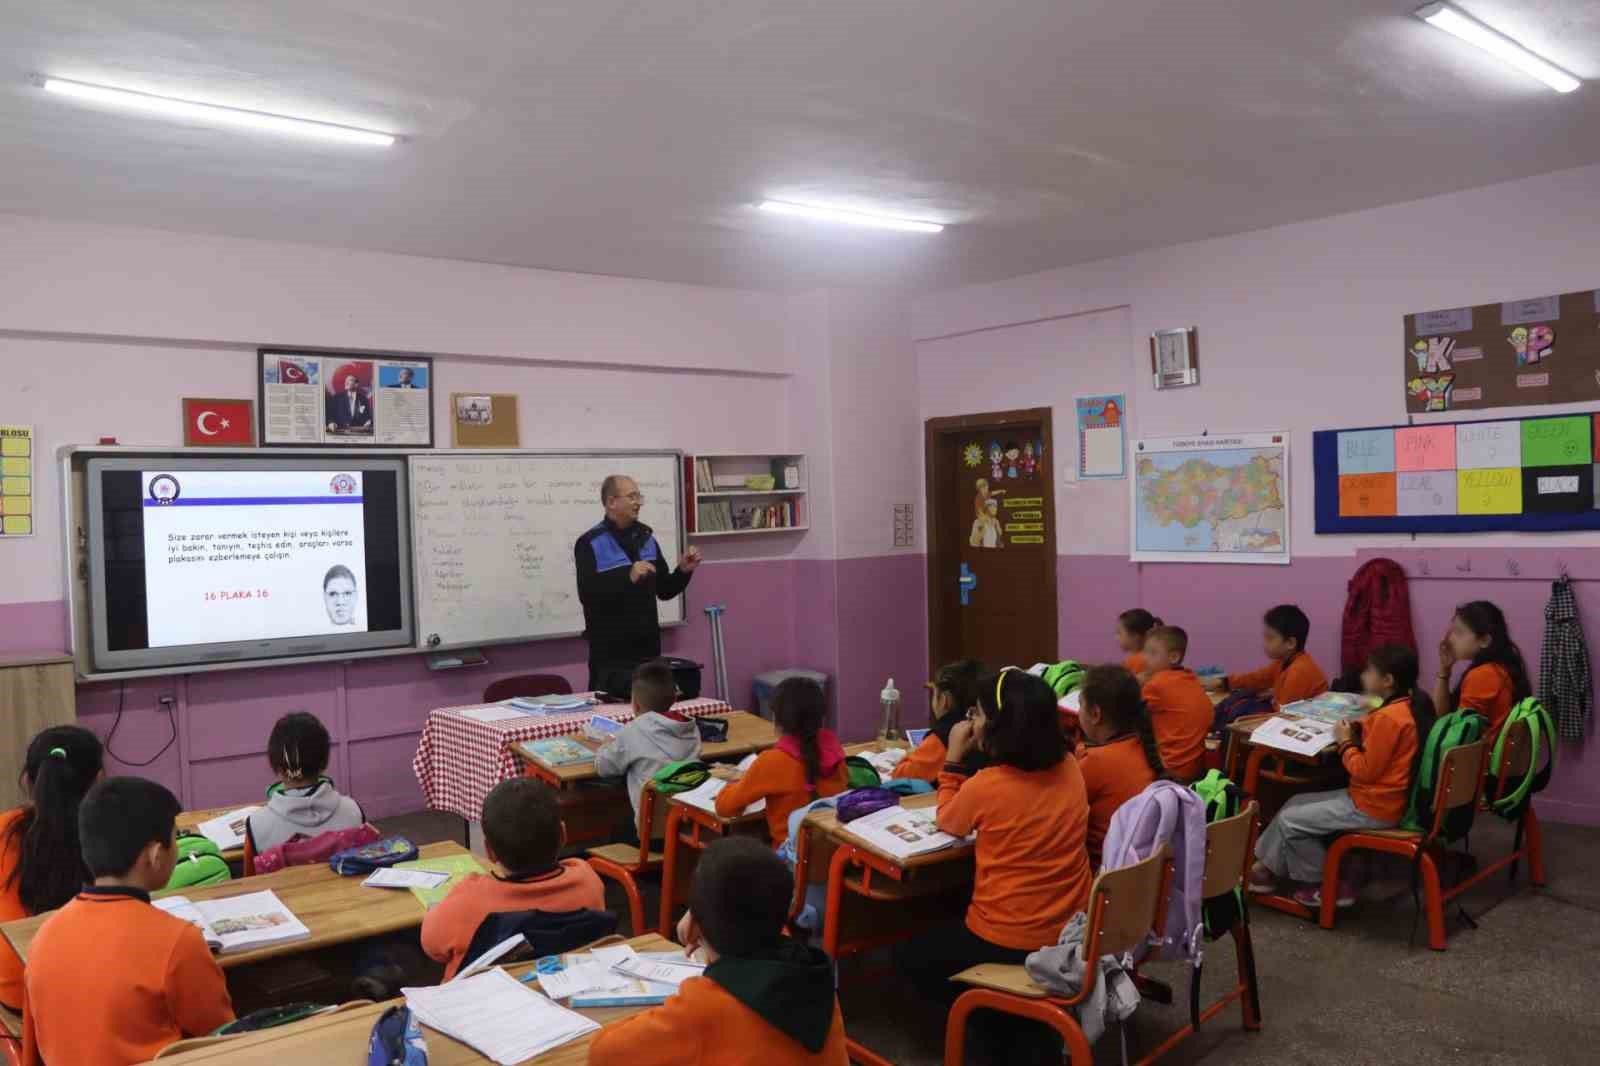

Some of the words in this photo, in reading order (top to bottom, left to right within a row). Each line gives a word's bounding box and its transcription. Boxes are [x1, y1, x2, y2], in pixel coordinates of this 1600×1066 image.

[168, 533, 186, 542] Size
[218, 531, 247, 540] vermek
[251, 530, 280, 540] isteyen
[284, 528, 297, 538] kişi
[300, 530, 319, 539] veya
[321, 527, 349, 538] kişilere
[248, 541, 272, 551] teşhis
[332, 539, 353, 547] varsa
[209, 552, 260, 563] ezberlemeye
[204, 592, 217, 601] 16
[220, 590, 253, 600] PLAKA
[256, 589, 269, 599] 16
